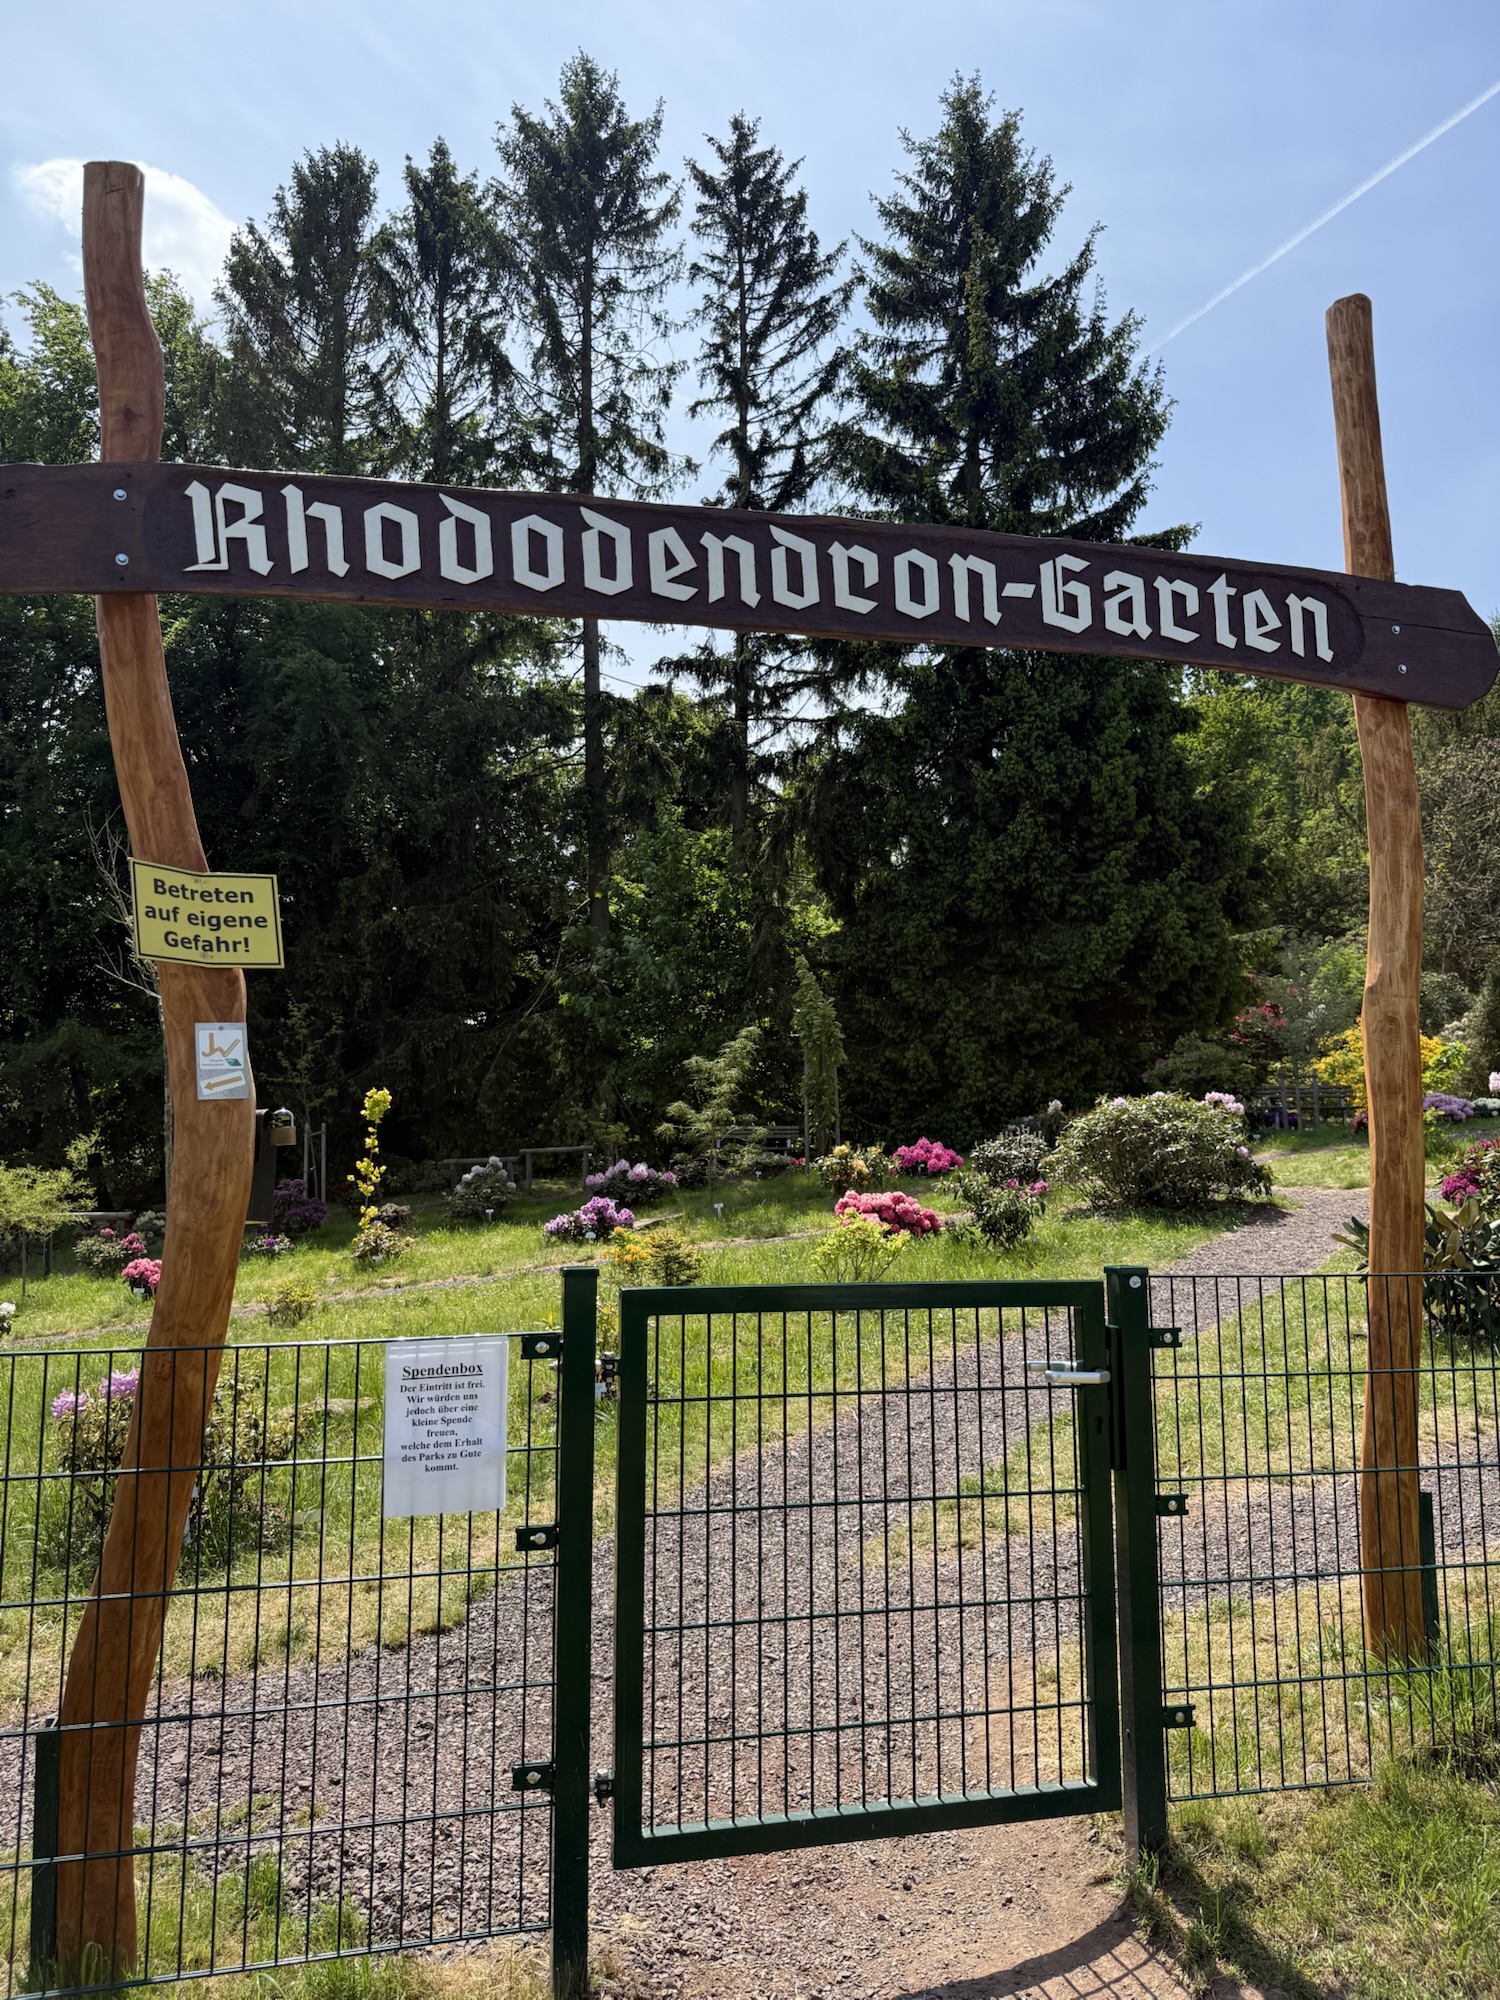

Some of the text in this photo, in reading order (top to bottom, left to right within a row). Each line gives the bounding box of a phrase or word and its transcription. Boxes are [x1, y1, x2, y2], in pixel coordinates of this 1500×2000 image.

[184, 480, 1334, 663] Rhododendron-Garten
[153, 877, 254, 904] Betreten
[145, 905, 268, 931] auf eigene
[164, 931, 250, 953] Gefahr!
[402, 1363, 483, 1380] Spendenbox
[400, 1380, 485, 1393] Der Eintritt ist frei.
[407, 1395, 425, 1404] Wir
[427, 1393, 460, 1402] würden
[405, 1404, 478, 1418] jedoch über eine
[412, 1415, 472, 1426] kleine Spende
[427, 1429, 458, 1437] freuen,
[401, 1437, 483, 1451] welche dem Erhalt
[402, 1453, 416, 1462] des
[419, 1452, 444, 1461] Parks
[460, 1450, 482, 1458] Gute
[425, 1463, 458, 1472] kommt.
